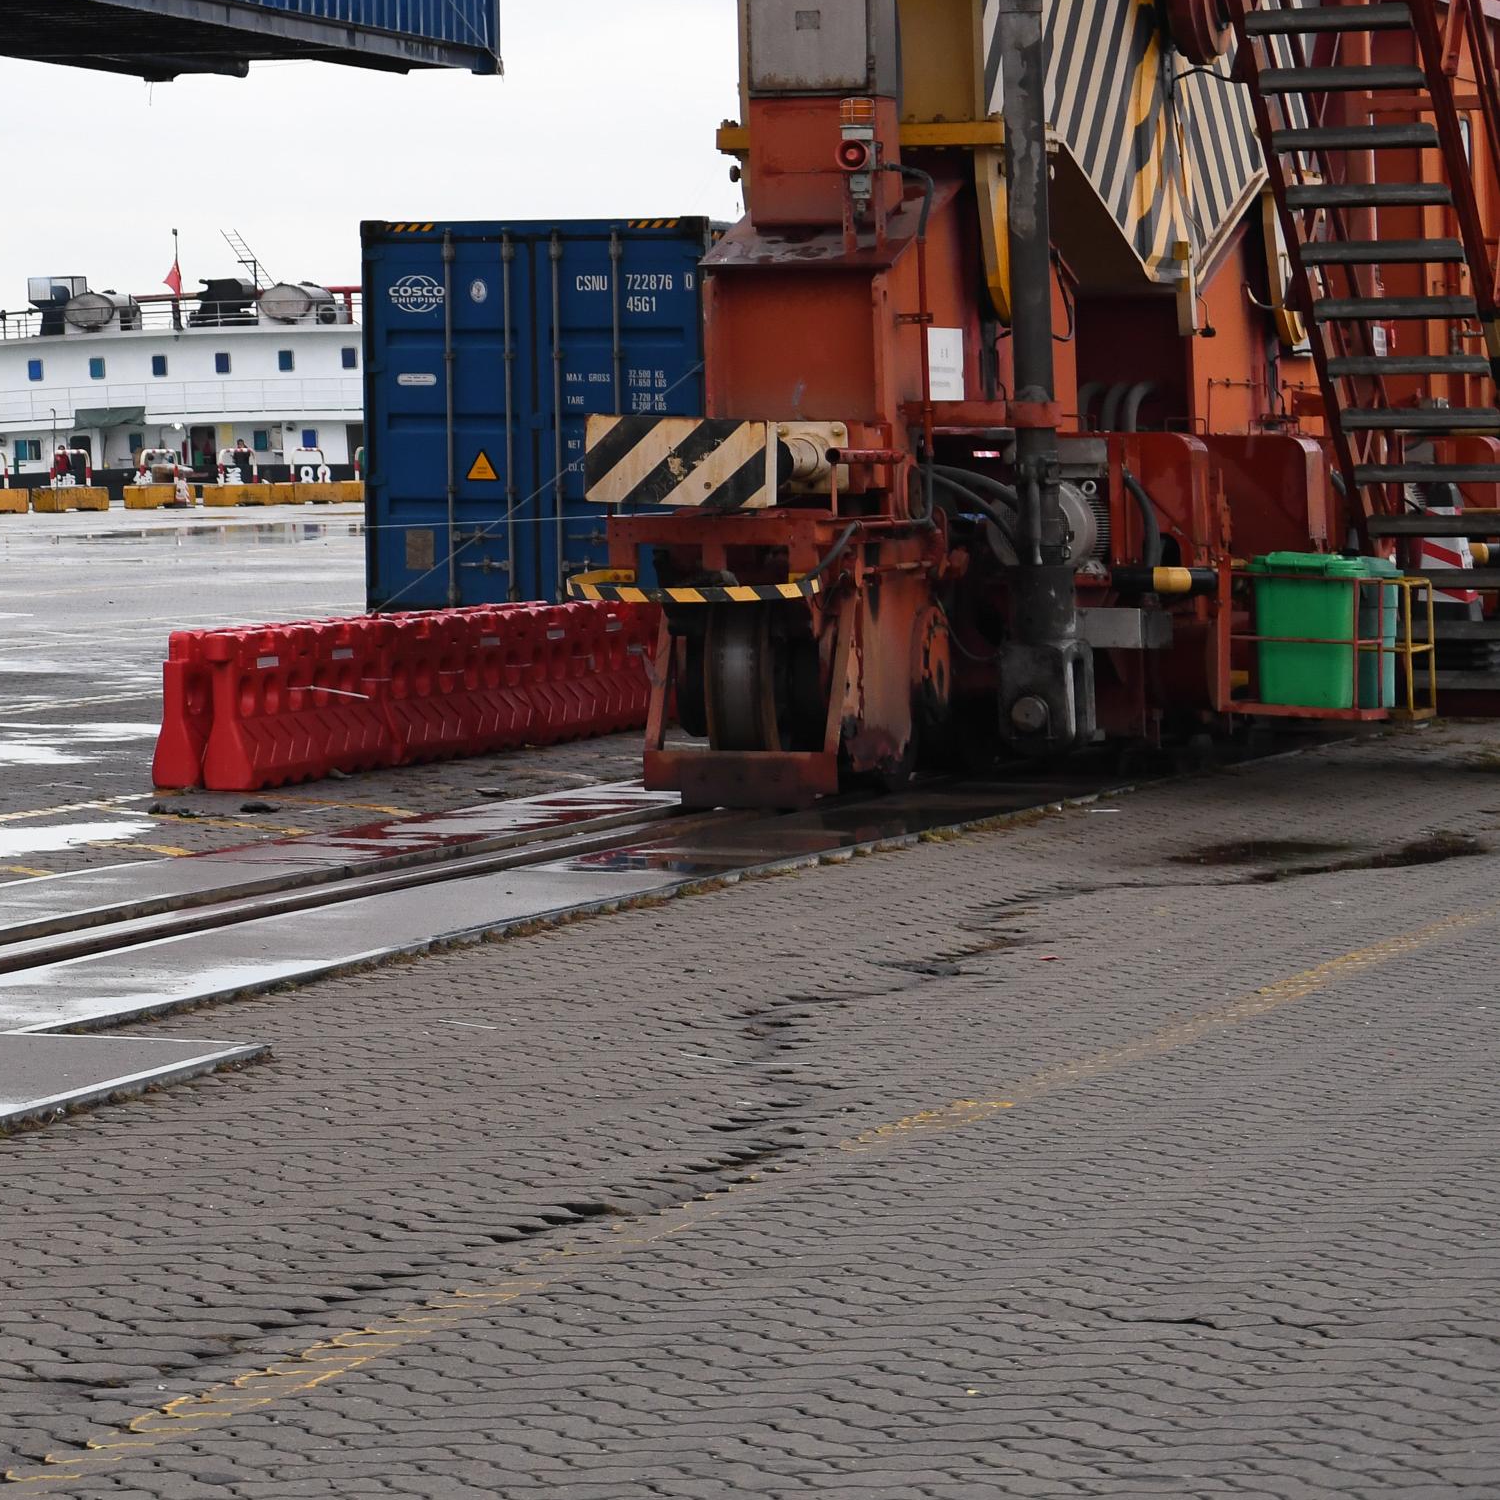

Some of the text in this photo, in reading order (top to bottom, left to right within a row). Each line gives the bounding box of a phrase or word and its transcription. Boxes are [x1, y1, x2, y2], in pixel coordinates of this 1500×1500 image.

[576, 275, 608, 291] CSNU
[625, 274, 673, 290] 722876
[388, 286, 446, 297] COSCO
[391, 296, 444, 304] SHIPPING
[626, 296, 656, 312] 45G1
[588, 373, 610, 383] GROSS
[654, 369, 664, 379] KG
[567, 395, 584, 405] TARE
[567, 440, 580, 449] NET
